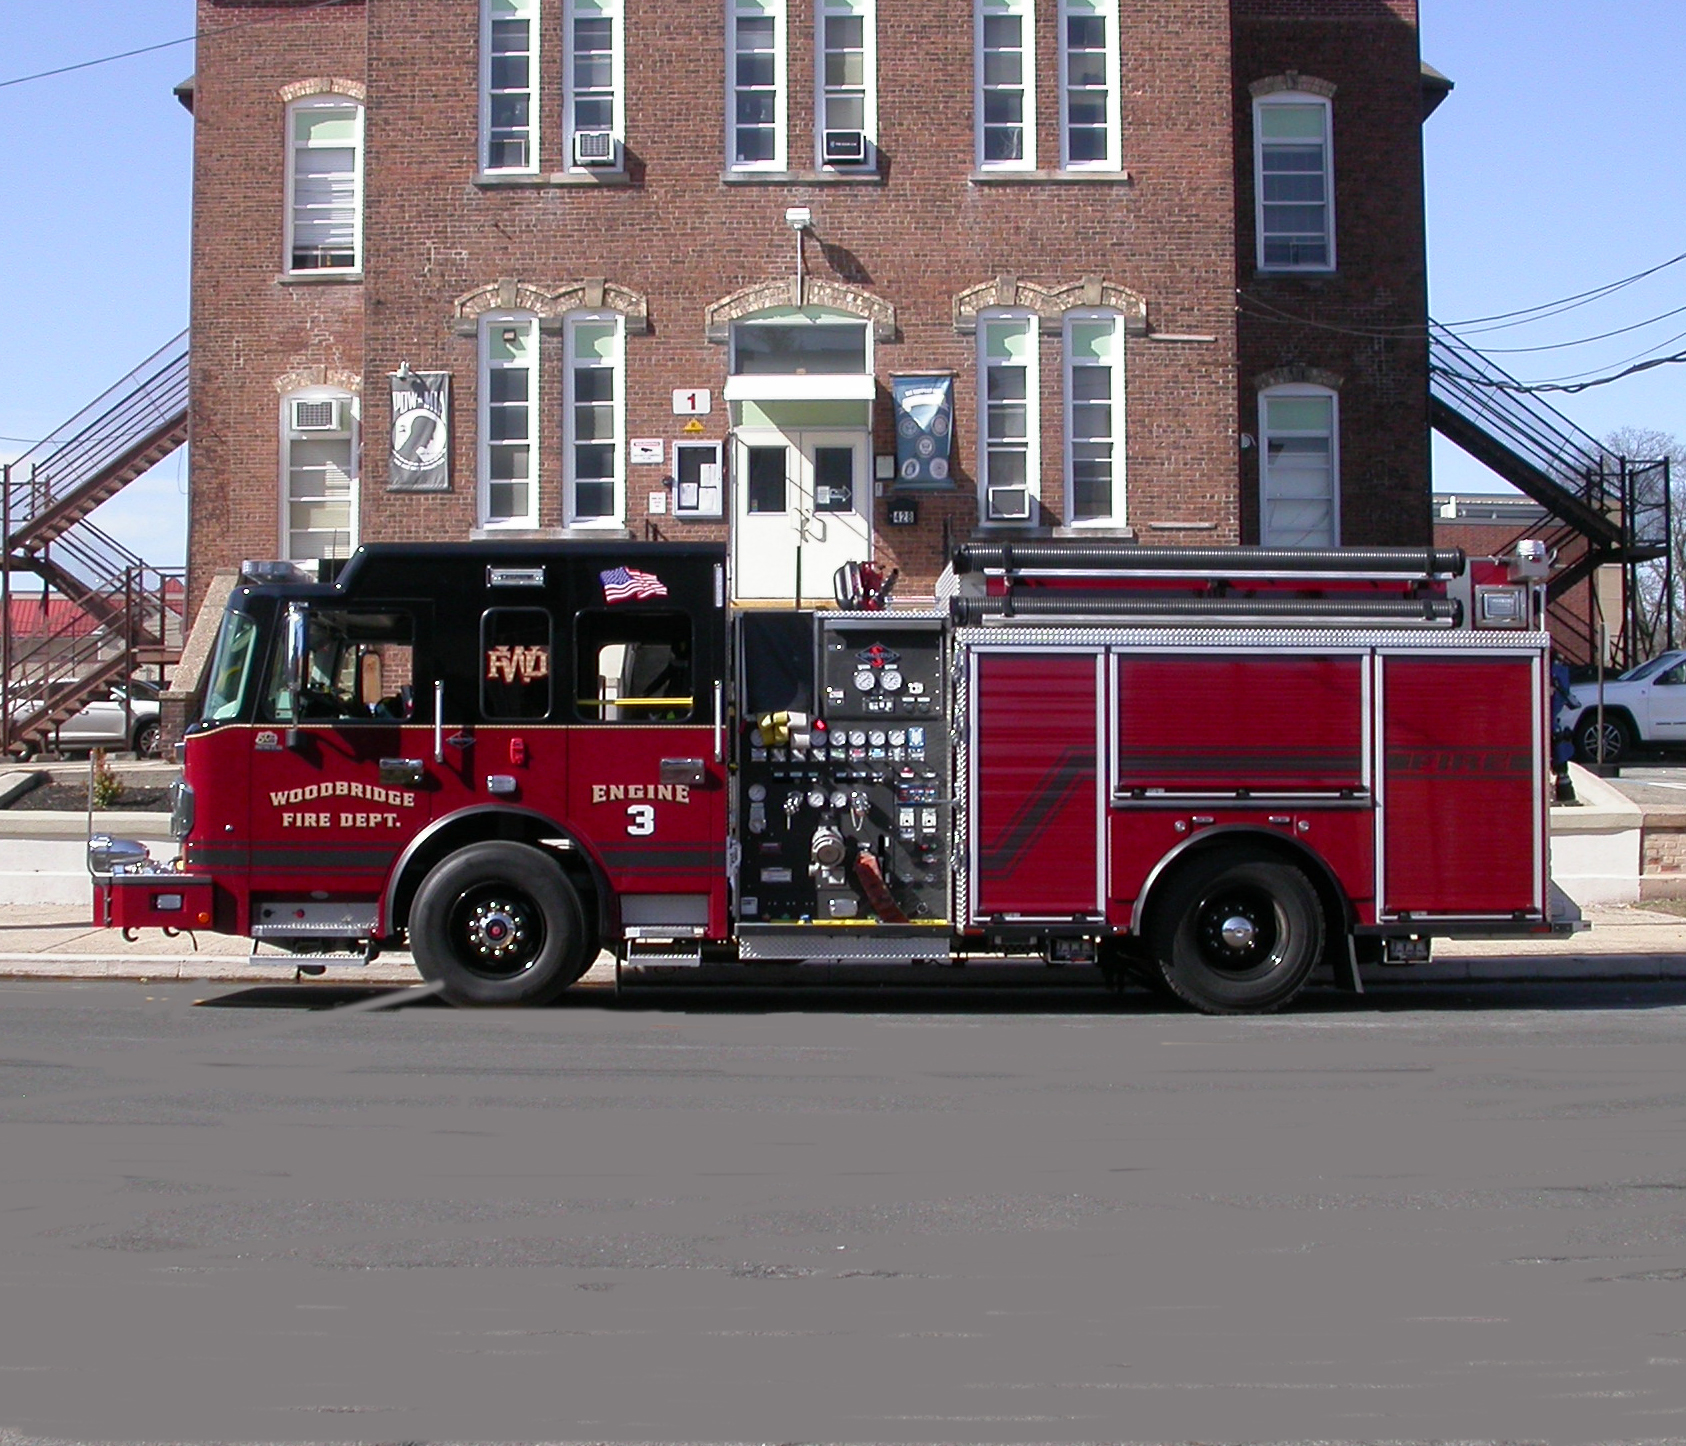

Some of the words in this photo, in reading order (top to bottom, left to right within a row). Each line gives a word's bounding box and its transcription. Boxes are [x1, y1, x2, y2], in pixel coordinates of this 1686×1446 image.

[392, 391, 417, 414] POW
[687, 393, 696, 410] 1
[269, 781, 415, 807] WOODBRIDGE
[592, 785, 690, 804] ENGINE
[282, 813, 331, 828] FIRE
[340, 813, 401, 828] DEPT.
[627, 804, 655, 836] 3
